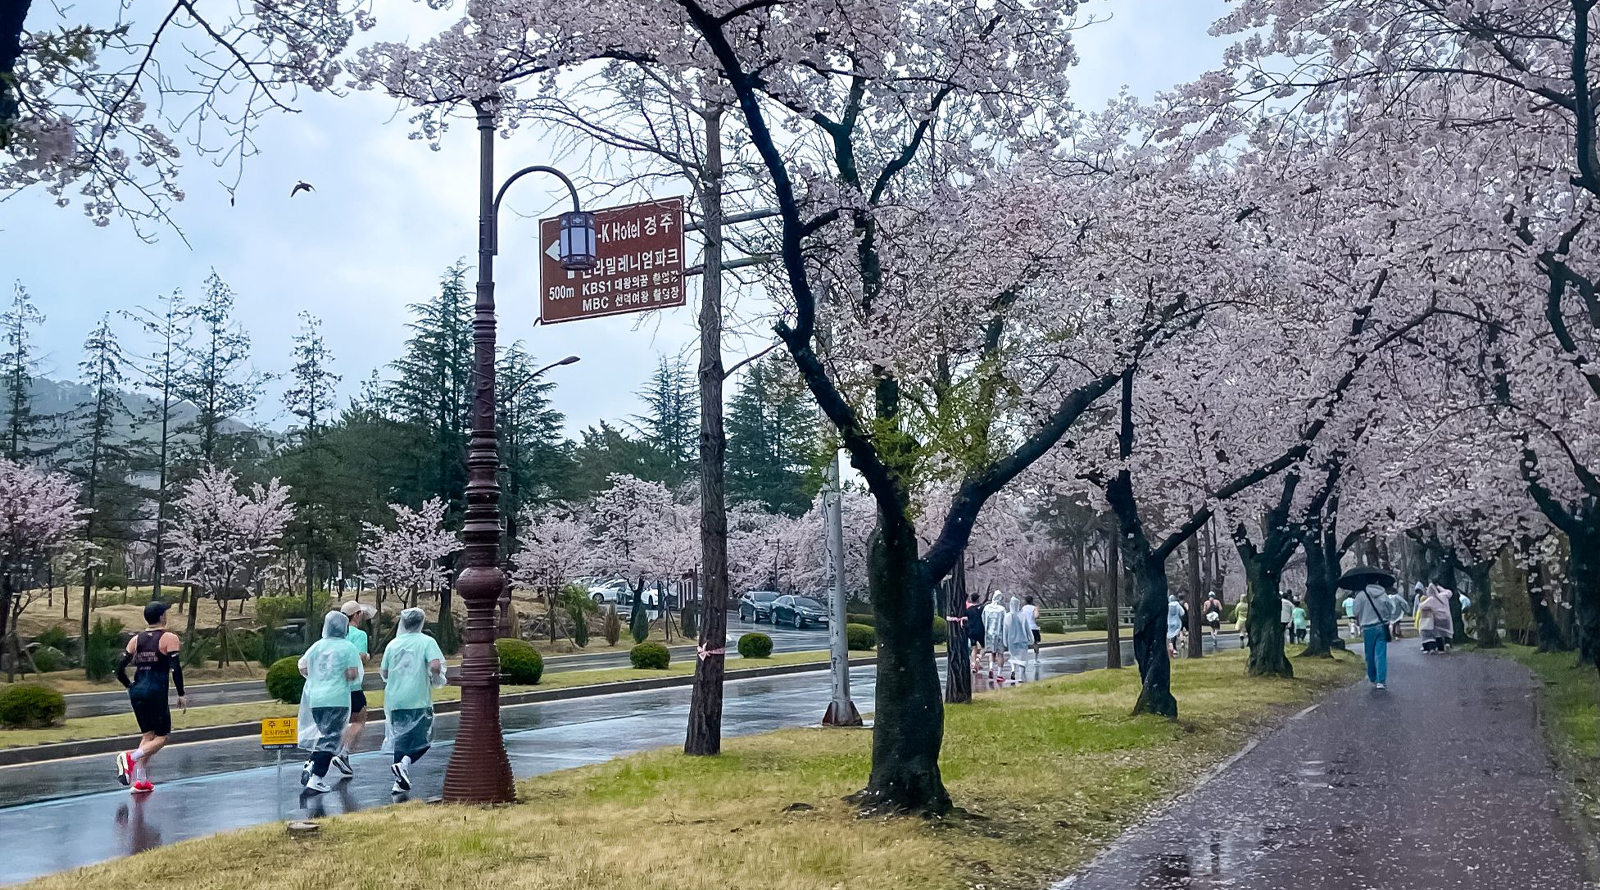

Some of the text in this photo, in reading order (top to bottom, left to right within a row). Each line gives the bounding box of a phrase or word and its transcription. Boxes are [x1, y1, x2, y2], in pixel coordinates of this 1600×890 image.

[612, 218, 640, 241] Hotel
[644, 213, 673, 236] 경주
[549, 285, 574, 300] 500m
[582, 280, 611, 296] KBS1
[615, 274, 649, 290] 대왕의꿈
[582, 296, 609, 311] MBC
[615, 290, 649, 307] 선덕여왕
